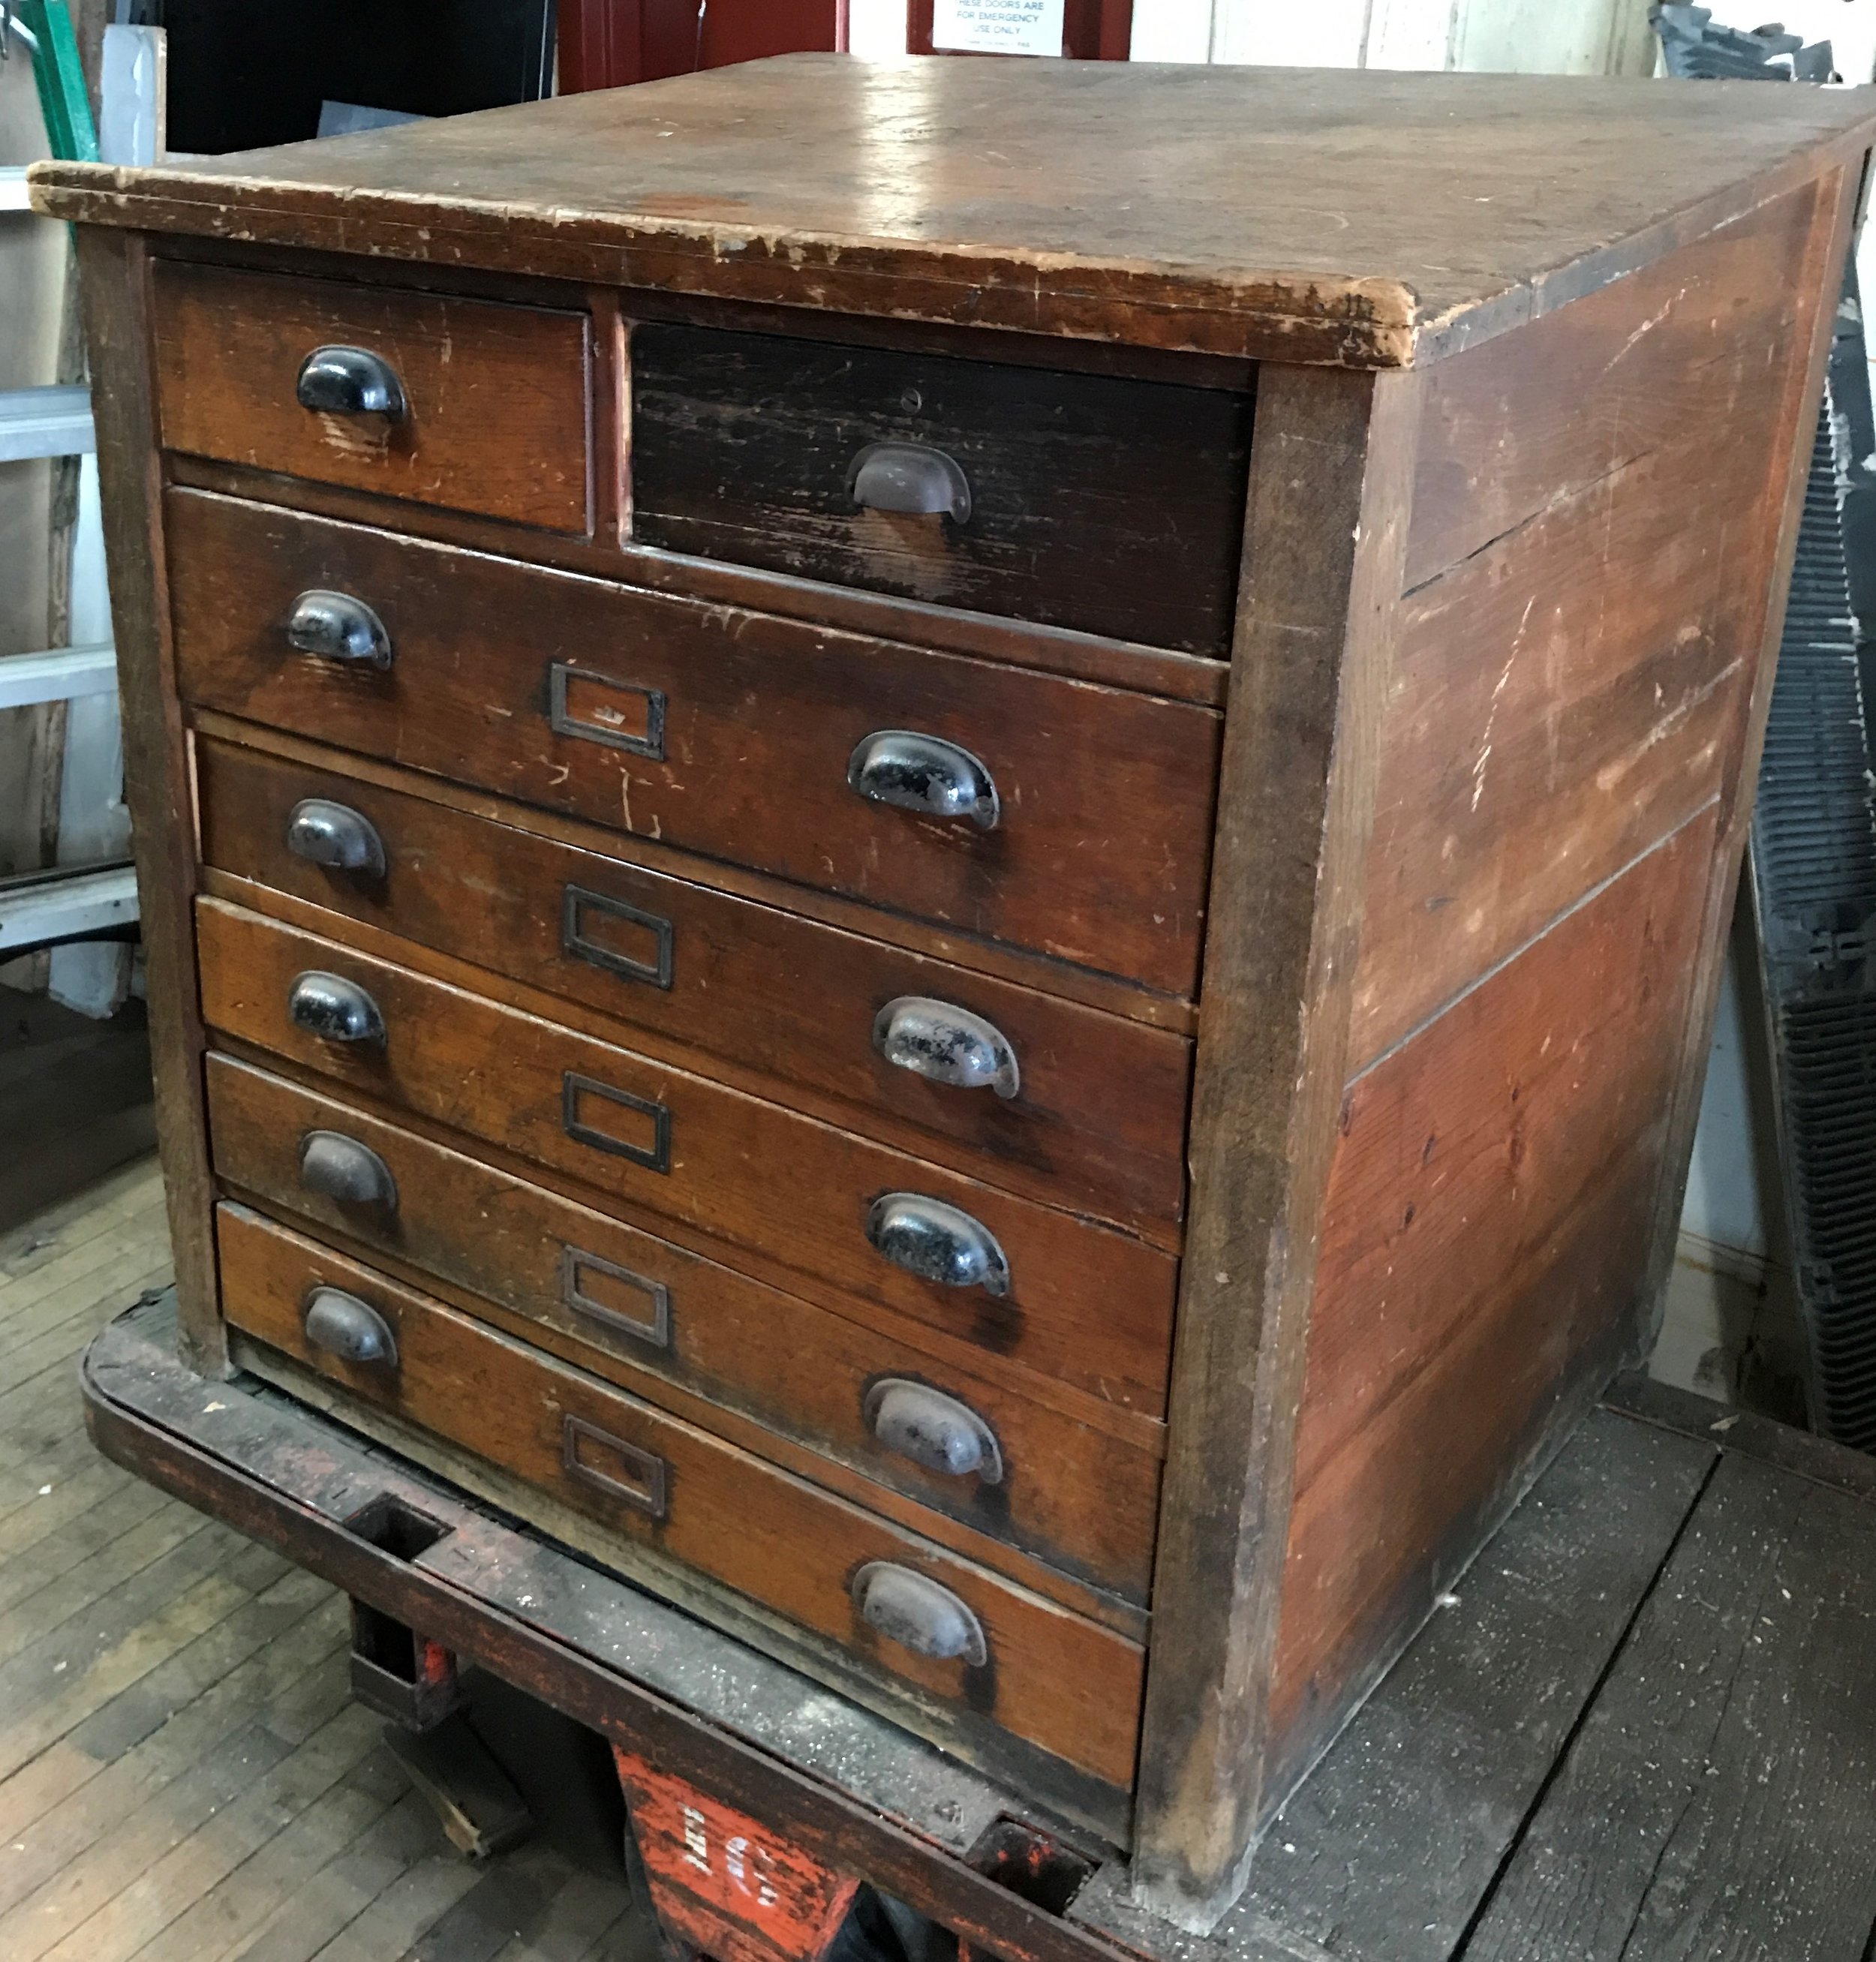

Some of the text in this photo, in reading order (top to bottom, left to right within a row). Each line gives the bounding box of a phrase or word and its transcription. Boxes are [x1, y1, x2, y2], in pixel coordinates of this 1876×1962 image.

[985, 0, 1021, 9] DOORS
[1024, 2, 1044, 11] ARE
[957, 11, 1039, 23] FOR EMERGENCY
[974, 25, 1021, 35] USE ONLY
